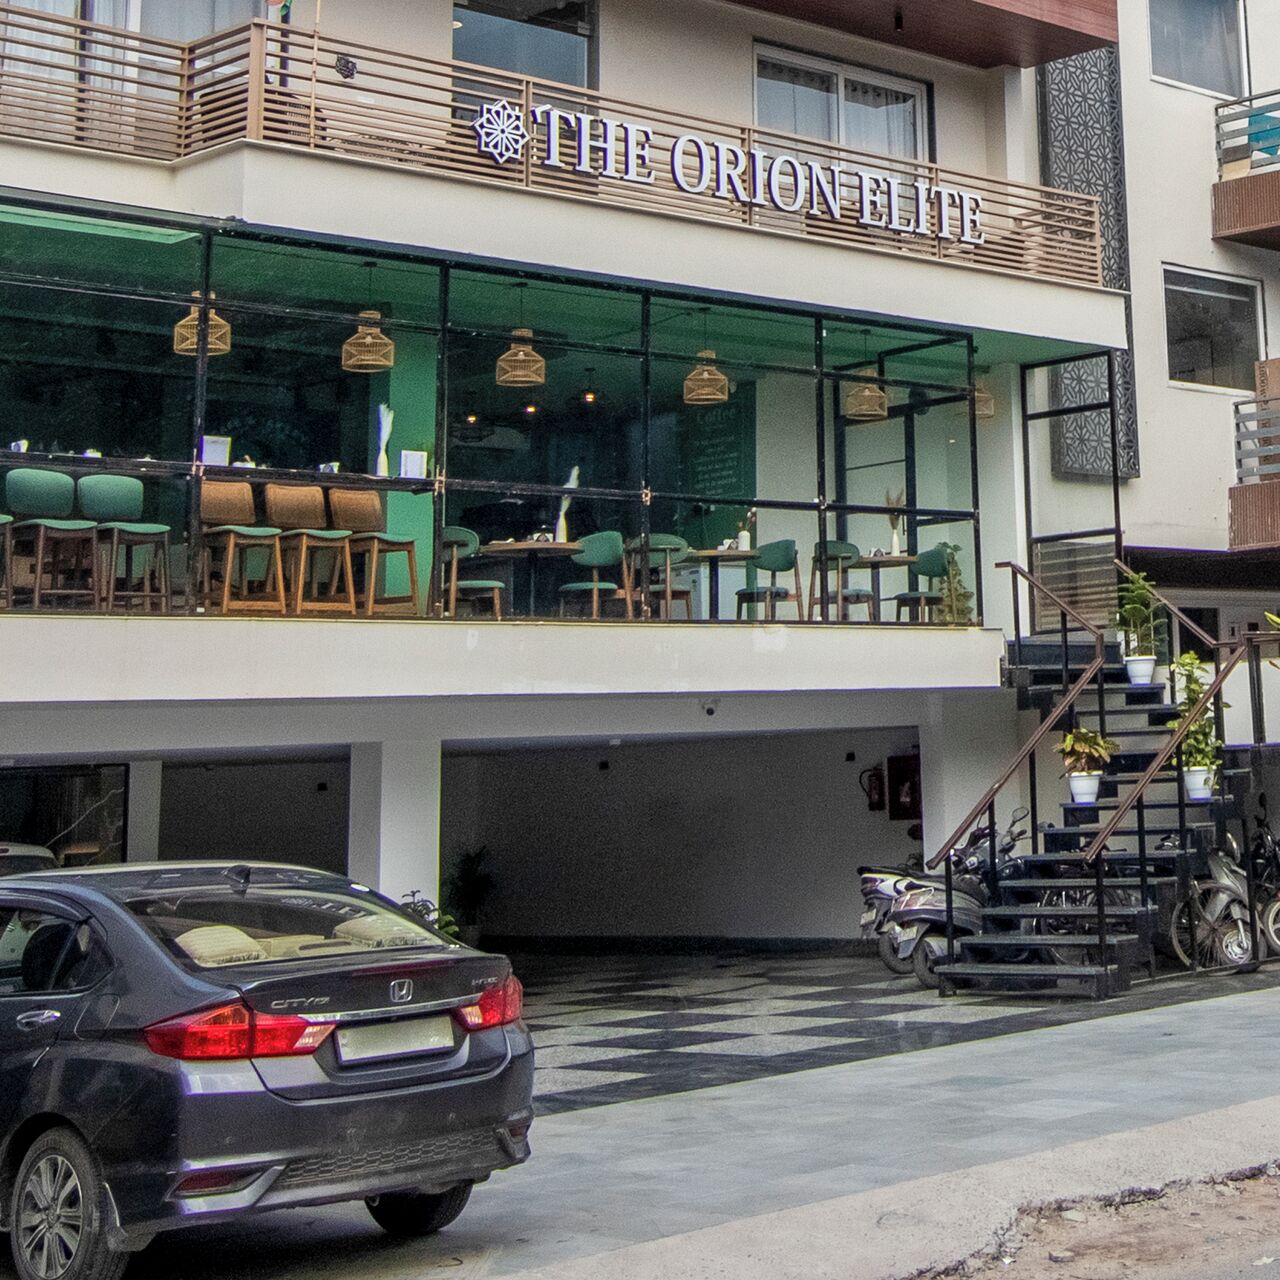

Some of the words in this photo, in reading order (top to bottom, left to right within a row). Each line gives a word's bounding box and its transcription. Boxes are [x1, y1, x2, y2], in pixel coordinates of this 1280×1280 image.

[531, 104, 656, 185] THE
[670, 134, 843, 220] ORION
[855, 170, 987, 246] ELITE
